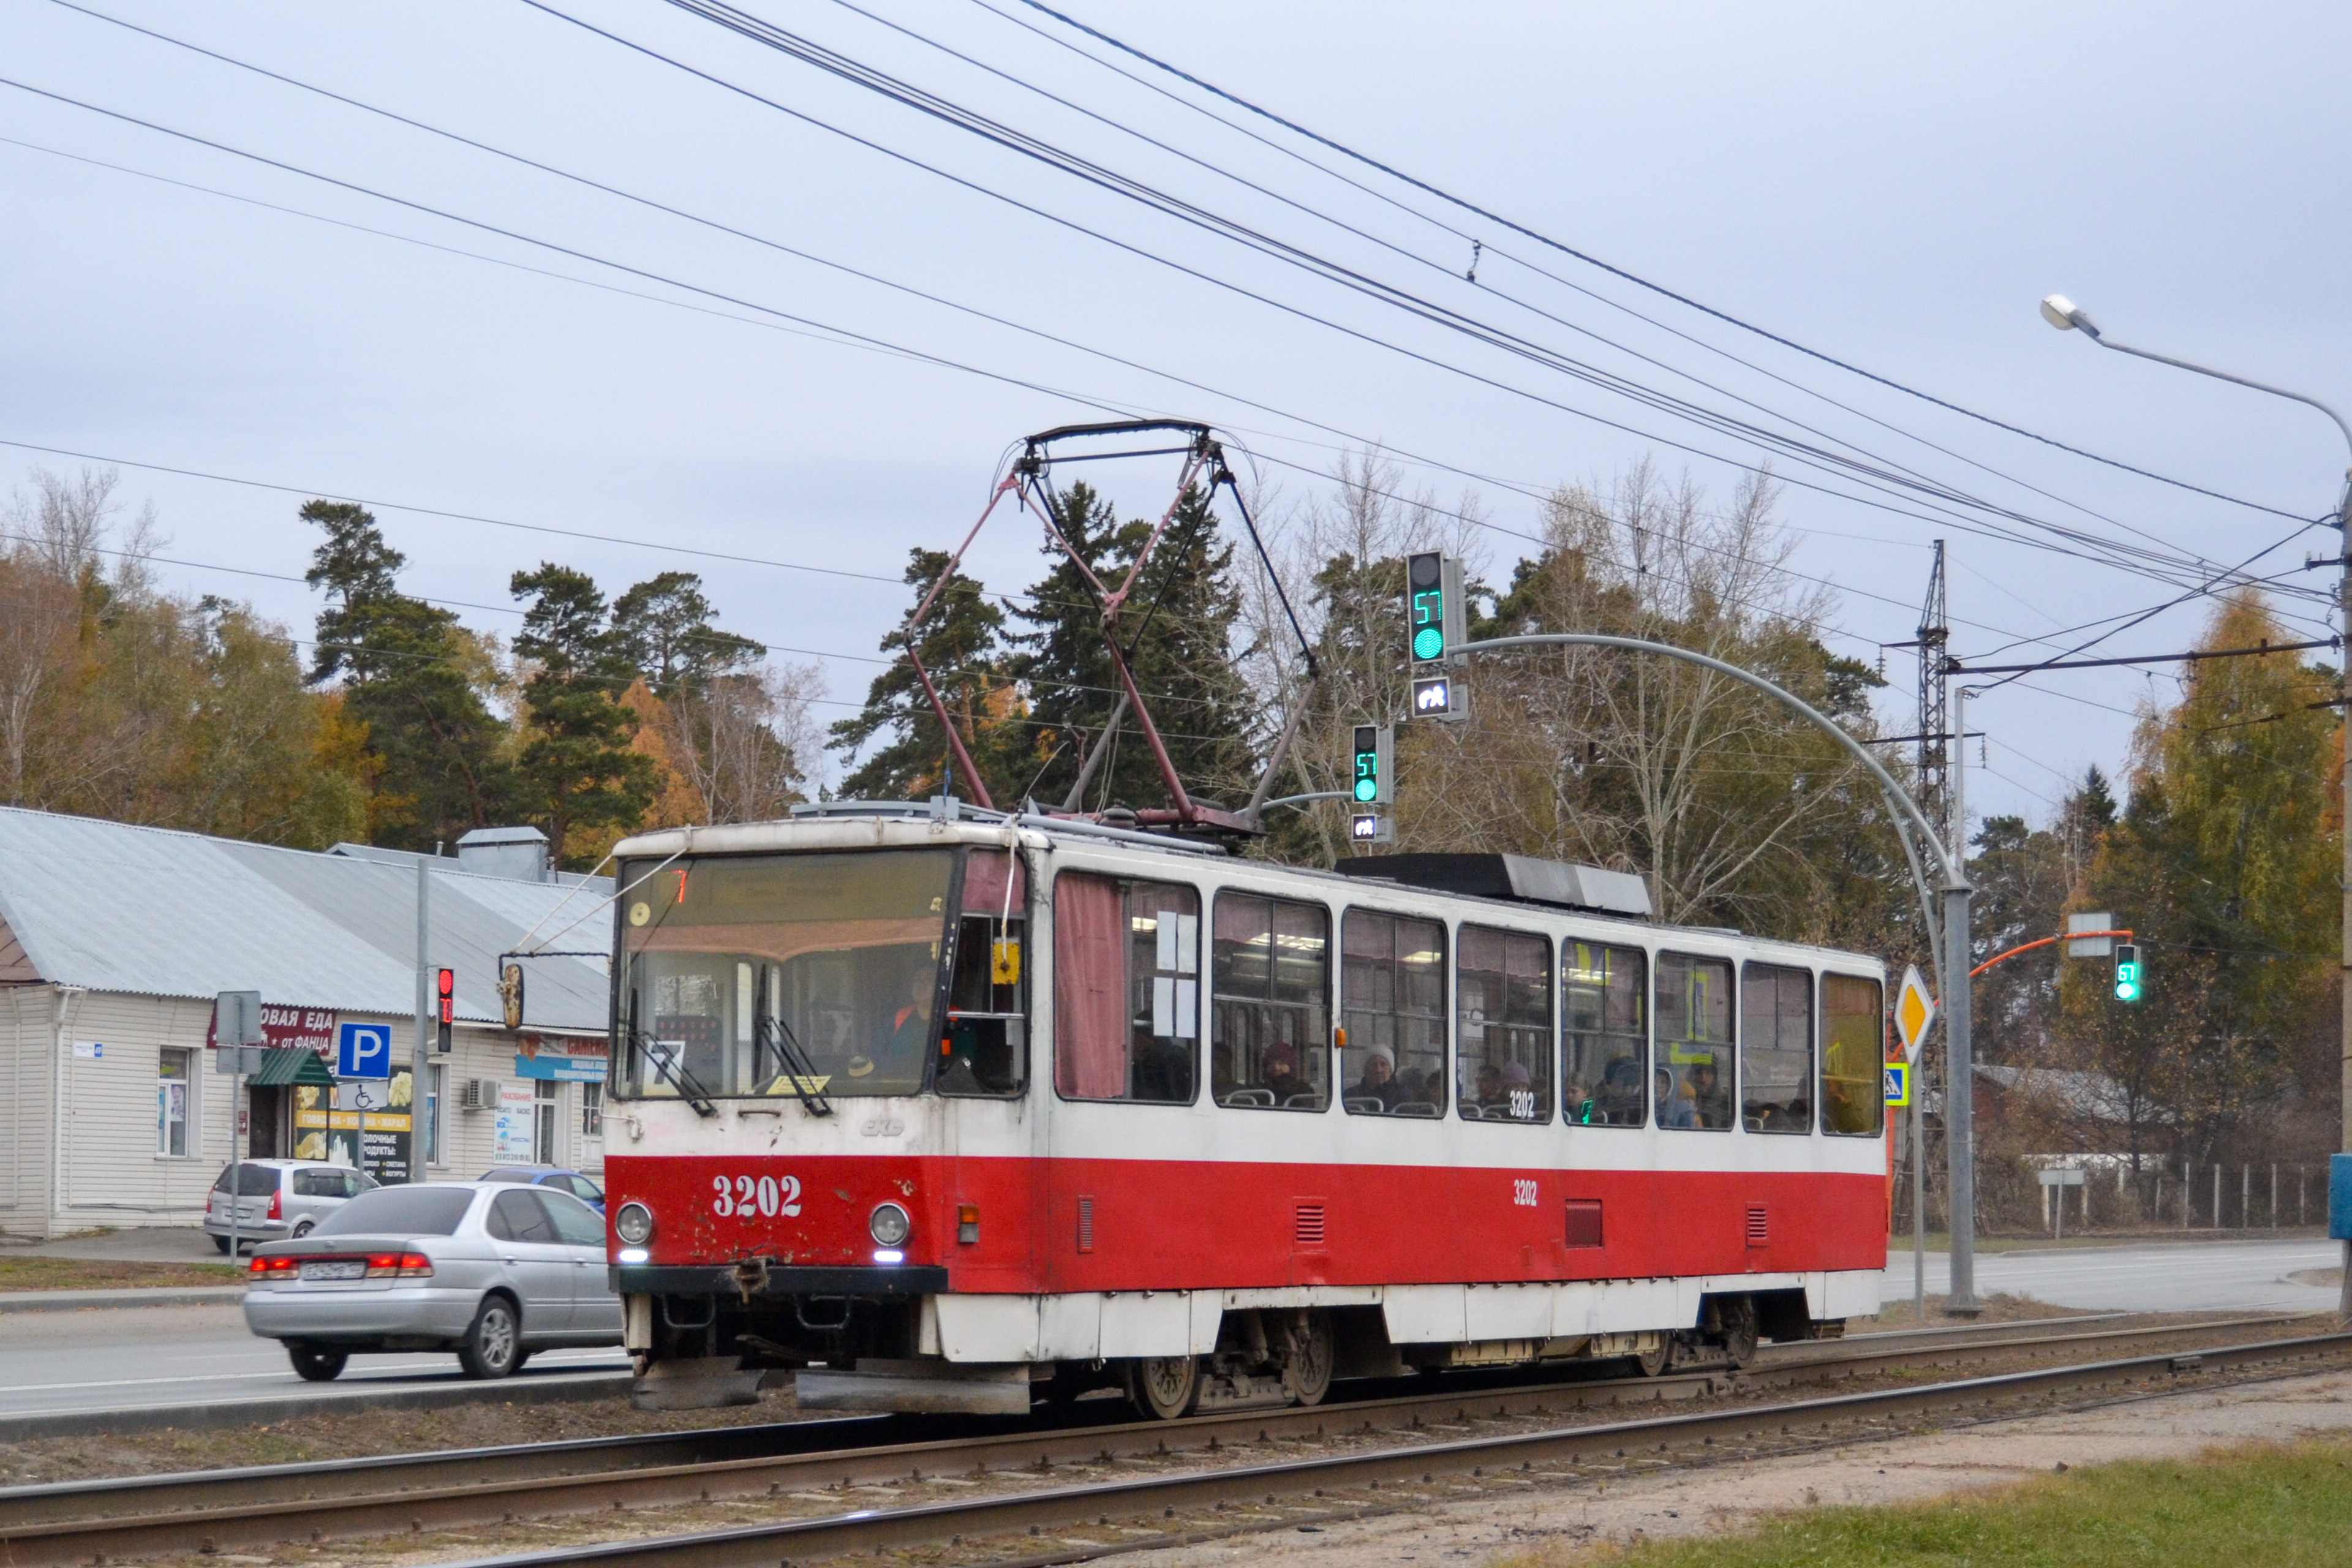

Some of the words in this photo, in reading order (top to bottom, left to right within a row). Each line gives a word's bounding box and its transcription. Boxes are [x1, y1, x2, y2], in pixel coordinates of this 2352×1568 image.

[1415, 591, 1442, 624] 57
[1357, 753, 1376, 775] 57
[2118, 964, 2135, 981] 67
[261, 1008, 300, 1027] ОВАЯ
[305, 1011, 333, 1031] ЕДА
[295, 1035, 329, 1052] ФАНЦА
[353, 1030, 382, 1071] P
[651, 1044, 682, 1085] 7
[500, 1092, 532, 1101] РАХОВАНИЕ
[1509, 1090, 1534, 1118] 3202
[302, 1114, 341, 1125] ГОВЯДНА
[364, 1133, 397, 1144] ОЛОЧНЫЕ
[364, 1145, 396, 1157] РОДУКТЫ:
[713, 1175, 802, 1217] 3202
[1513, 1178, 1537, 1207] 3202
